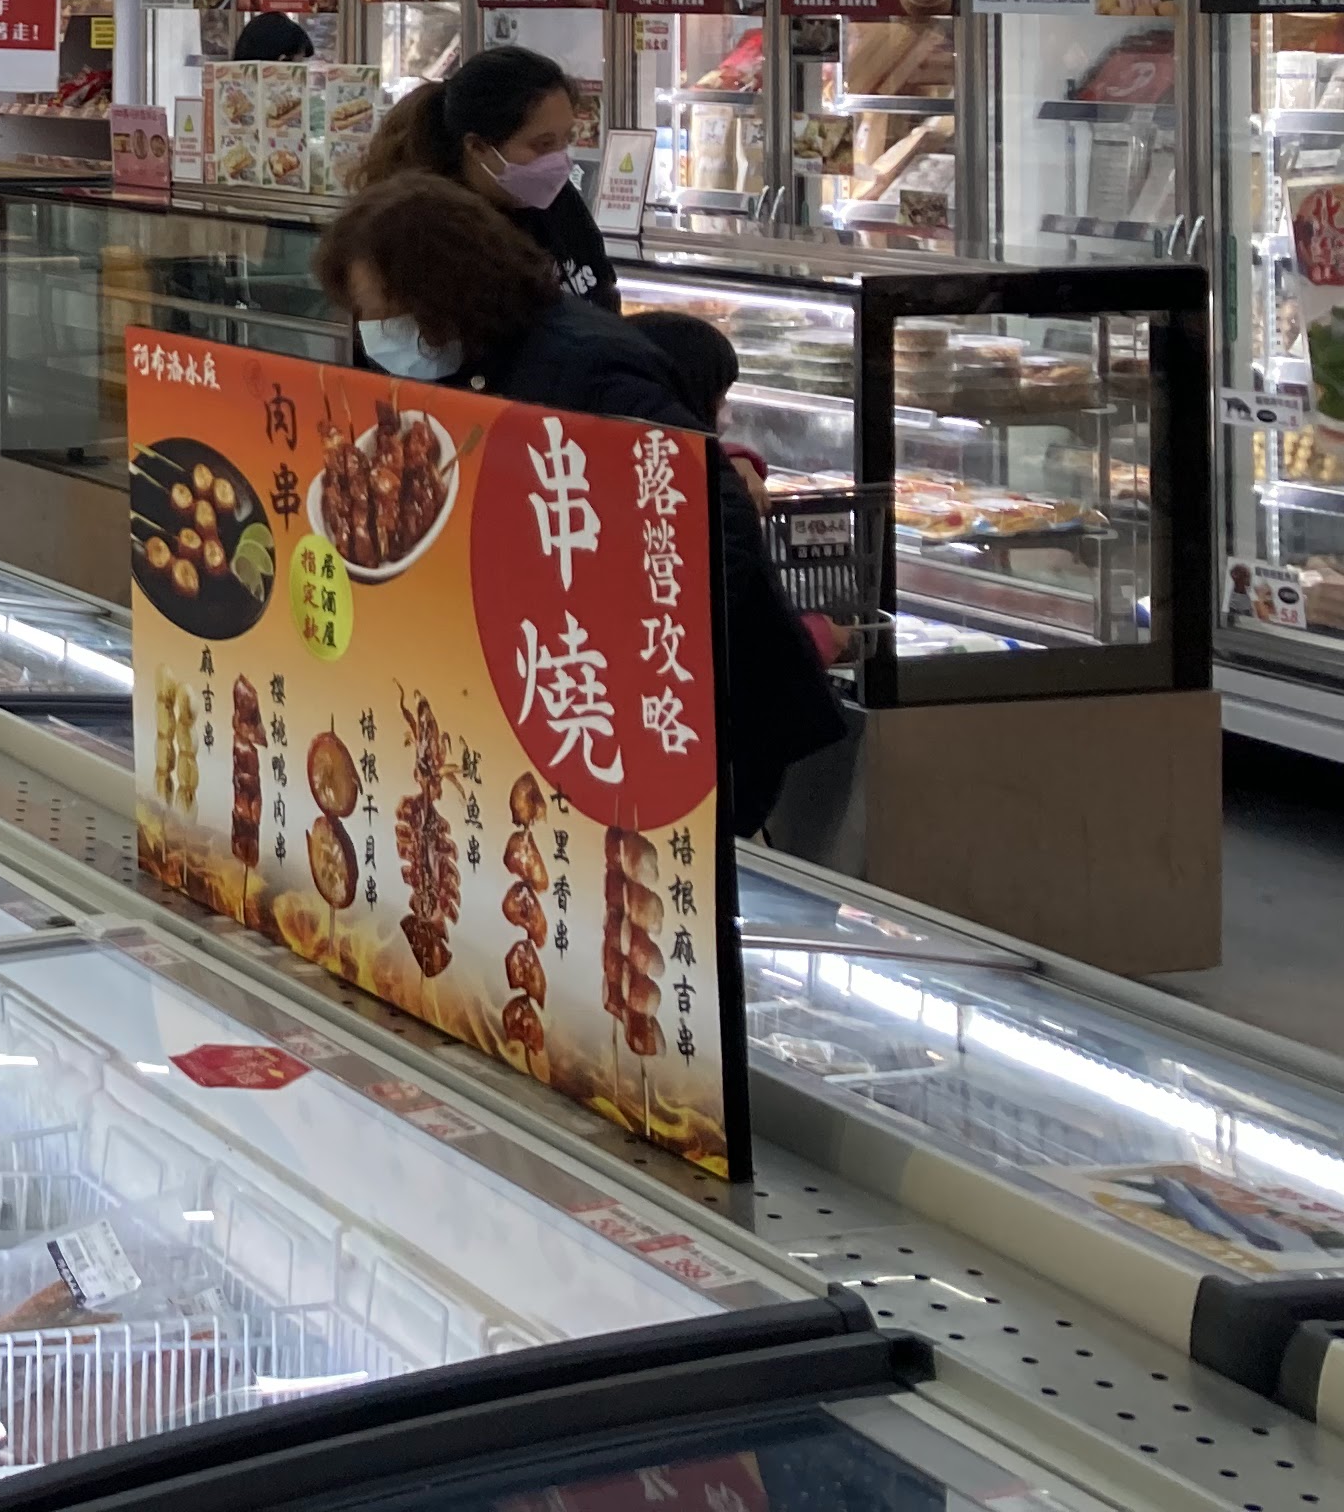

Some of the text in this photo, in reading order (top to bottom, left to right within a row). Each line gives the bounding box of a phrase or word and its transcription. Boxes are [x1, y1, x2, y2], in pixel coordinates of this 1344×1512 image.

[517, 416, 625, 785] 串燒
[632, 428, 701, 756] 露營攻略
[198, 642, 216, 754] 麻吉串
[268, 671, 290, 869] 櫻桃鴨肉串
[358, 707, 380, 912] 培根干貝串
[461, 735, 484, 874] 魷魚串
[549, 786, 574, 962] 七里香串
[668, 827, 699, 1068] 培根麻吉串
